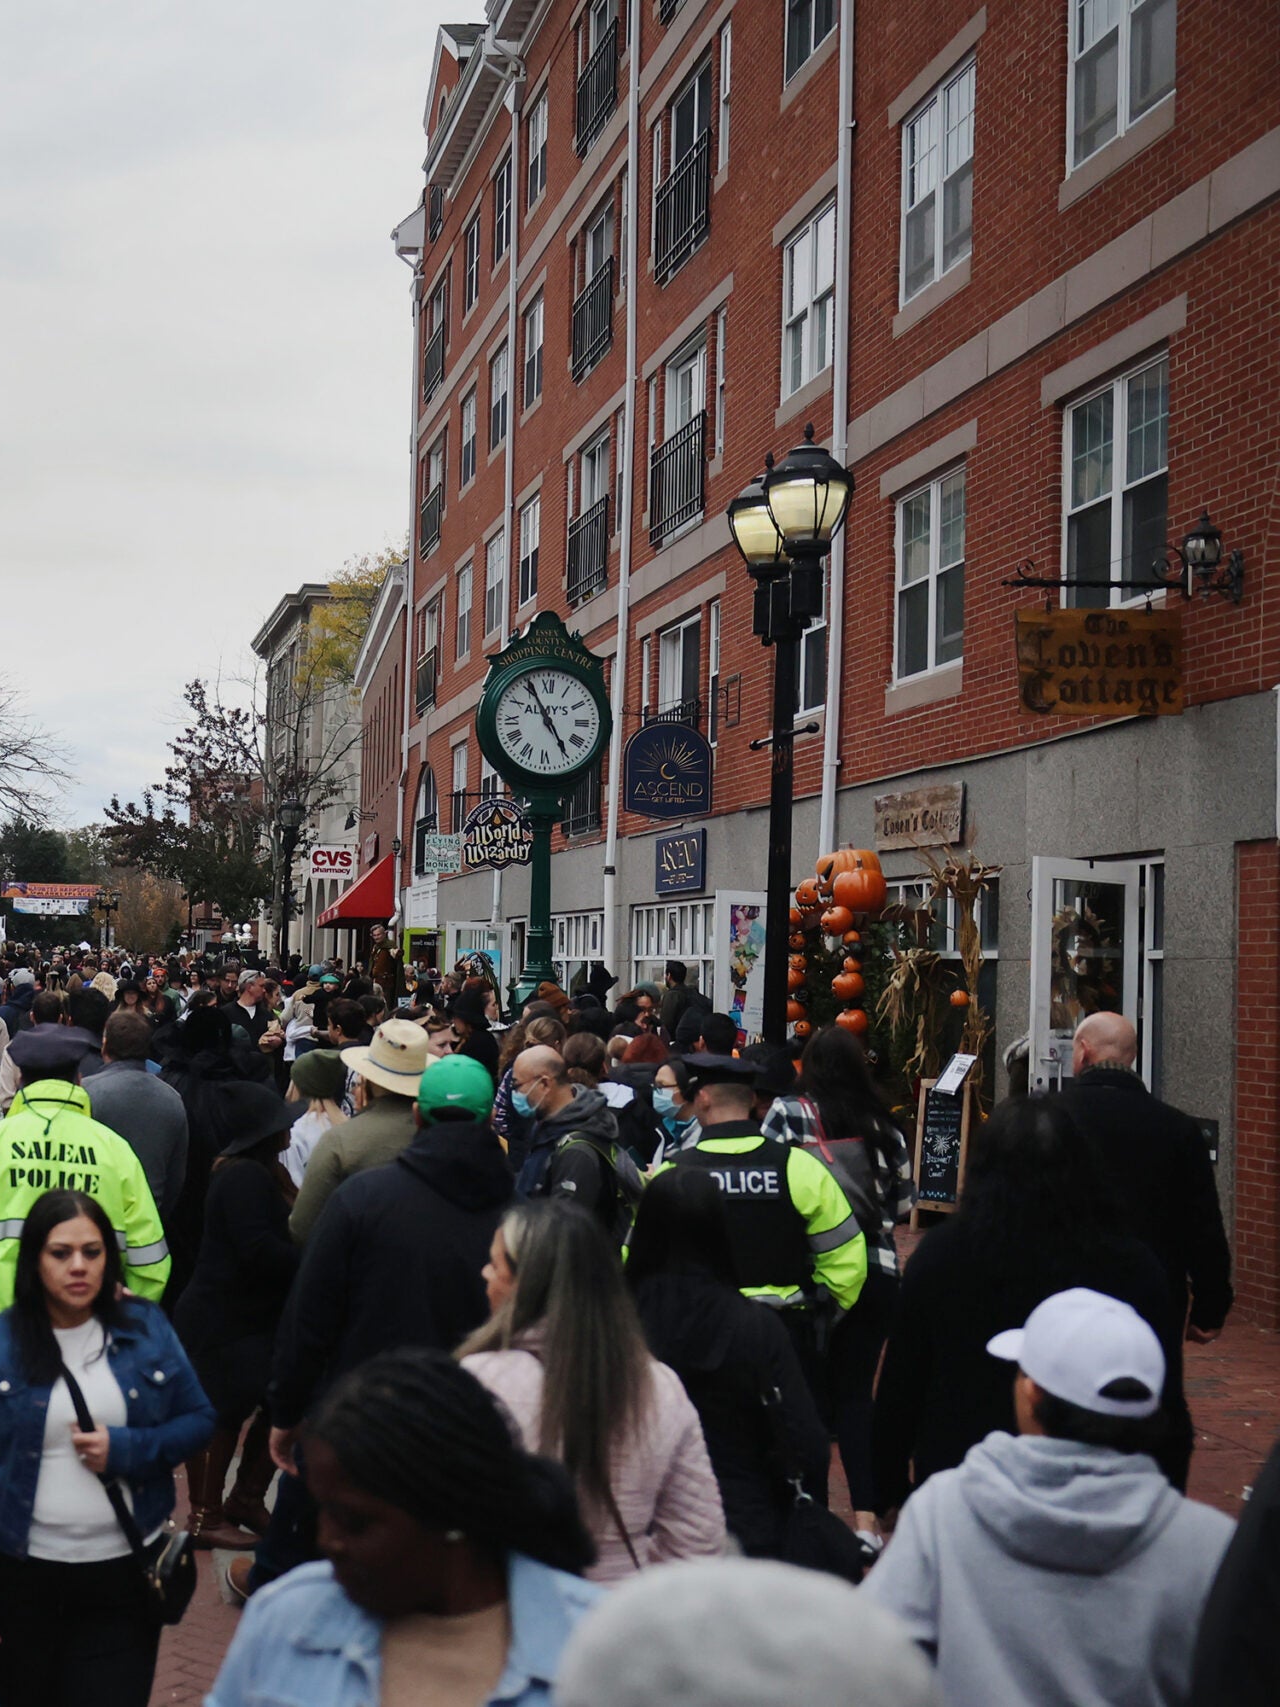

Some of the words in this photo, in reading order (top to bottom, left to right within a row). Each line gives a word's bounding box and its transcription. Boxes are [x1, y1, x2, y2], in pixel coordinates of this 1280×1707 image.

[498, 645, 550, 667] SHOPPING
[553, 646, 594, 670] CENTRE
[1023, 668, 1180, 714] Cottage
[634, 781, 704, 797] ASCEND
[474, 821, 522, 846] World
[496, 838, 506, 848] of
[312, 850, 352, 867] CVS
[466, 842, 531, 864] Wizardry
[312, 867, 351, 875] pharmacy
[426, 861, 460, 869] MONKEY
[11, 1141, 97, 1165] SALEM
[10, 1168, 100, 1194] POLICE
[709, 1170, 780, 1194] OLICE
